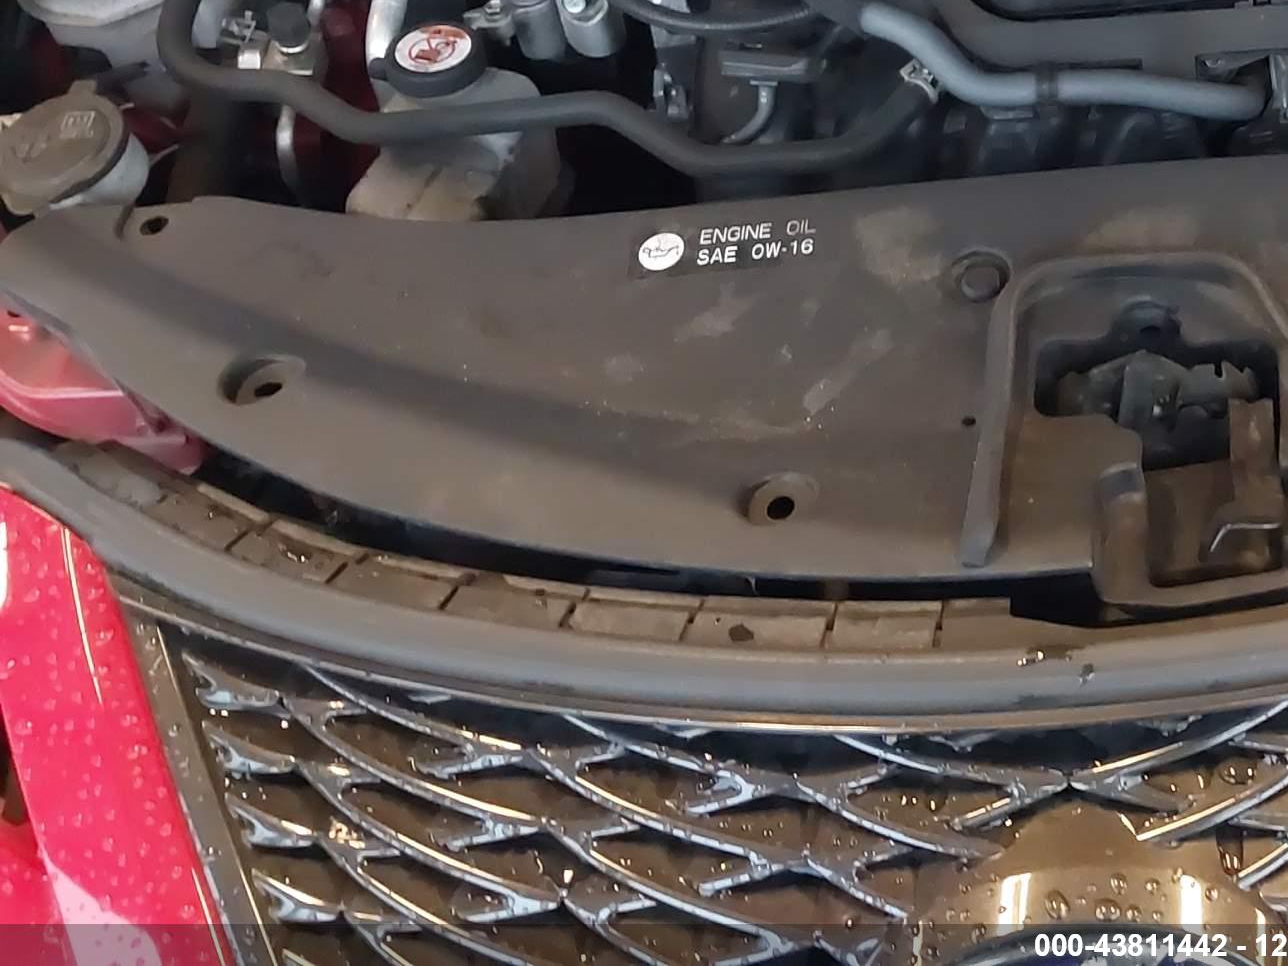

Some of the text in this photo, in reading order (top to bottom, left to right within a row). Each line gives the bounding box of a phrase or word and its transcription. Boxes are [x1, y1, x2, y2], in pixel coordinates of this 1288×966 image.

[699, 218, 817, 245] ENGINE OIL
[696, 245, 738, 266] SAE
